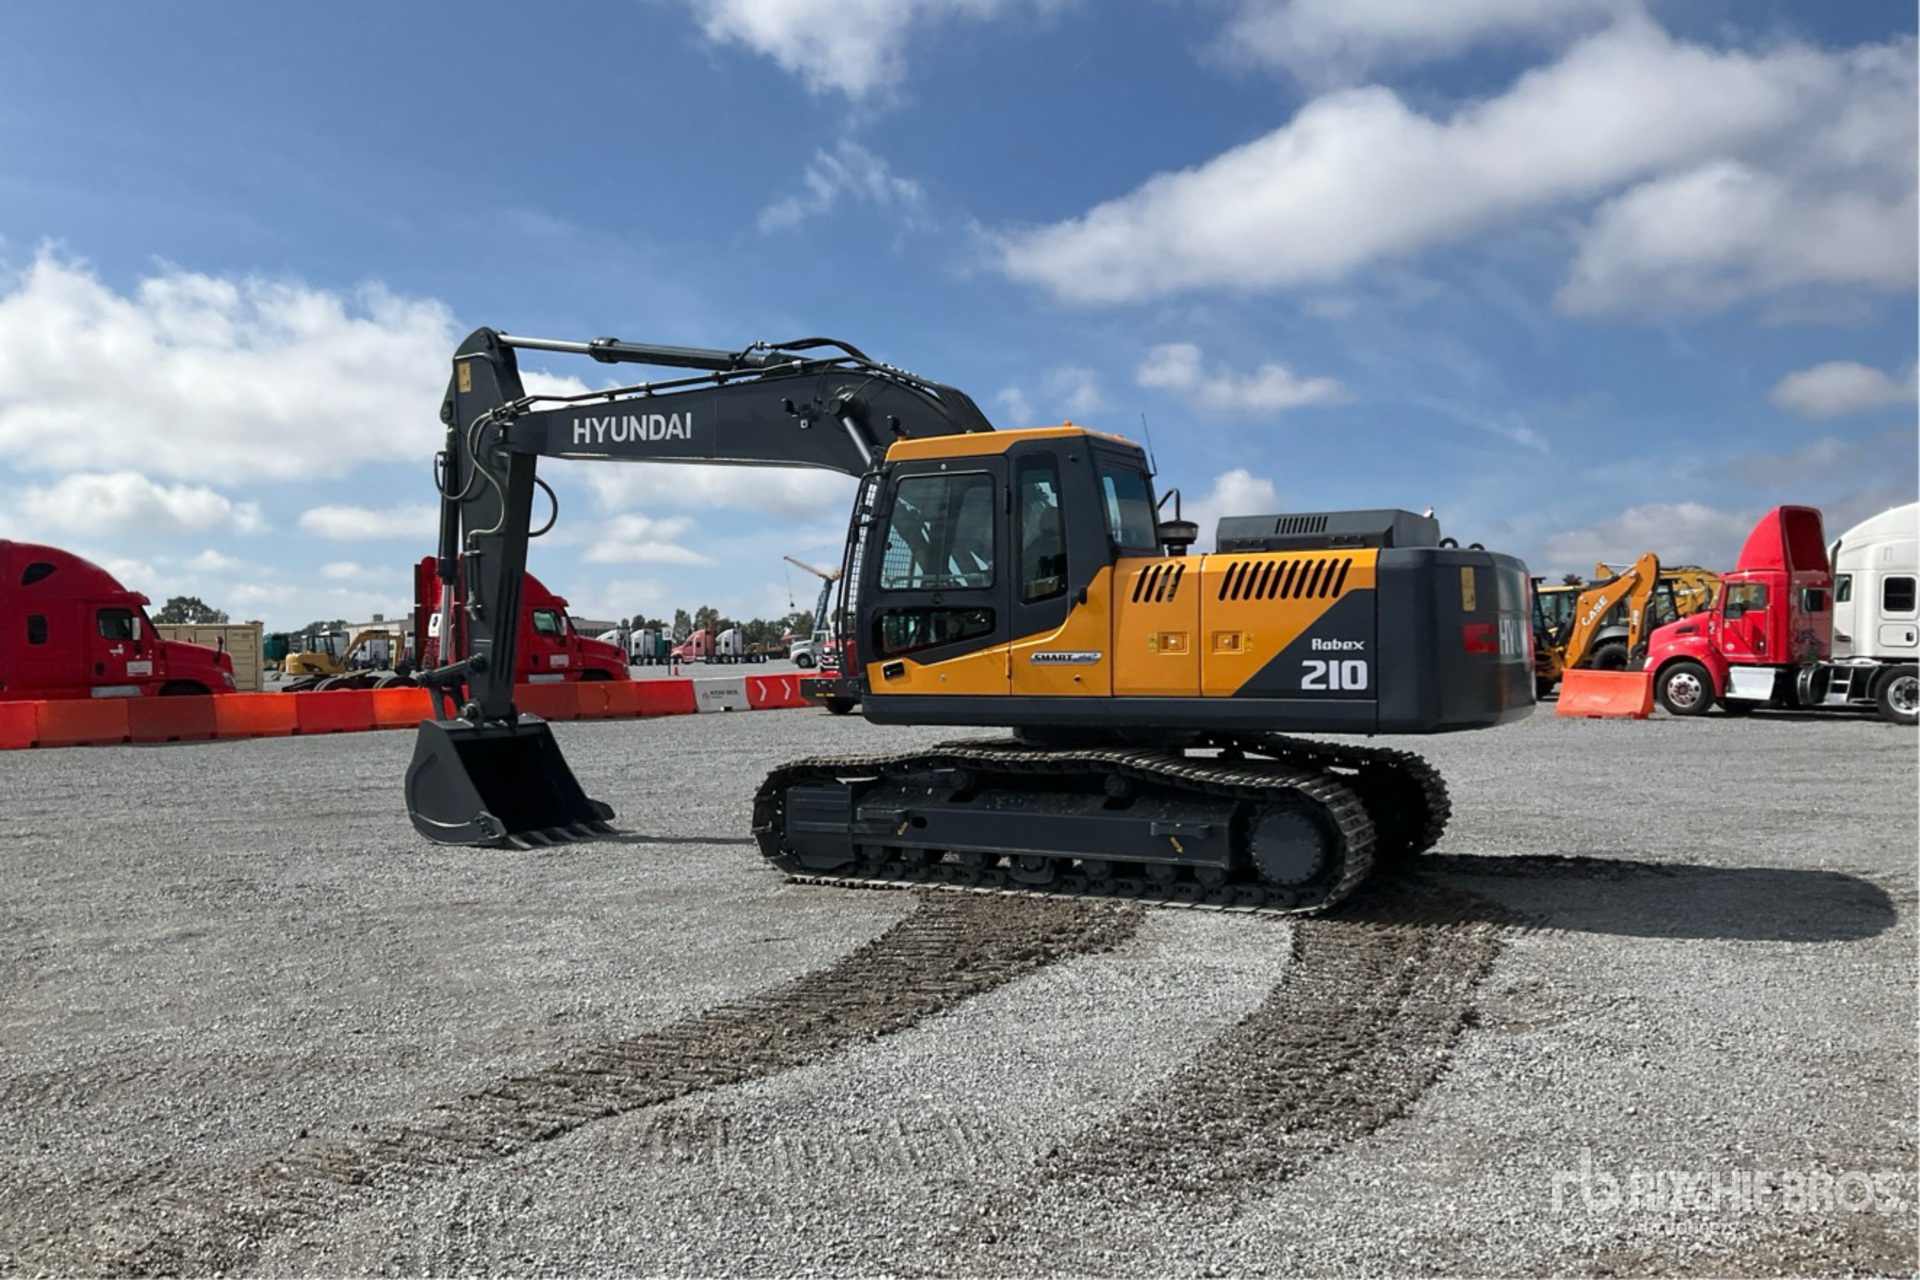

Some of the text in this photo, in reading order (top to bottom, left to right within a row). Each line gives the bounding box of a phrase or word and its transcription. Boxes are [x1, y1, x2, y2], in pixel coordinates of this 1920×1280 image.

[573, 412, 692, 444] HYUNDAI
[1581, 595, 1608, 626] CASE
[1034, 653, 1073, 662] SMART
[1311, 637, 1366, 651] Robex
[1301, 659, 1368, 690] 210
